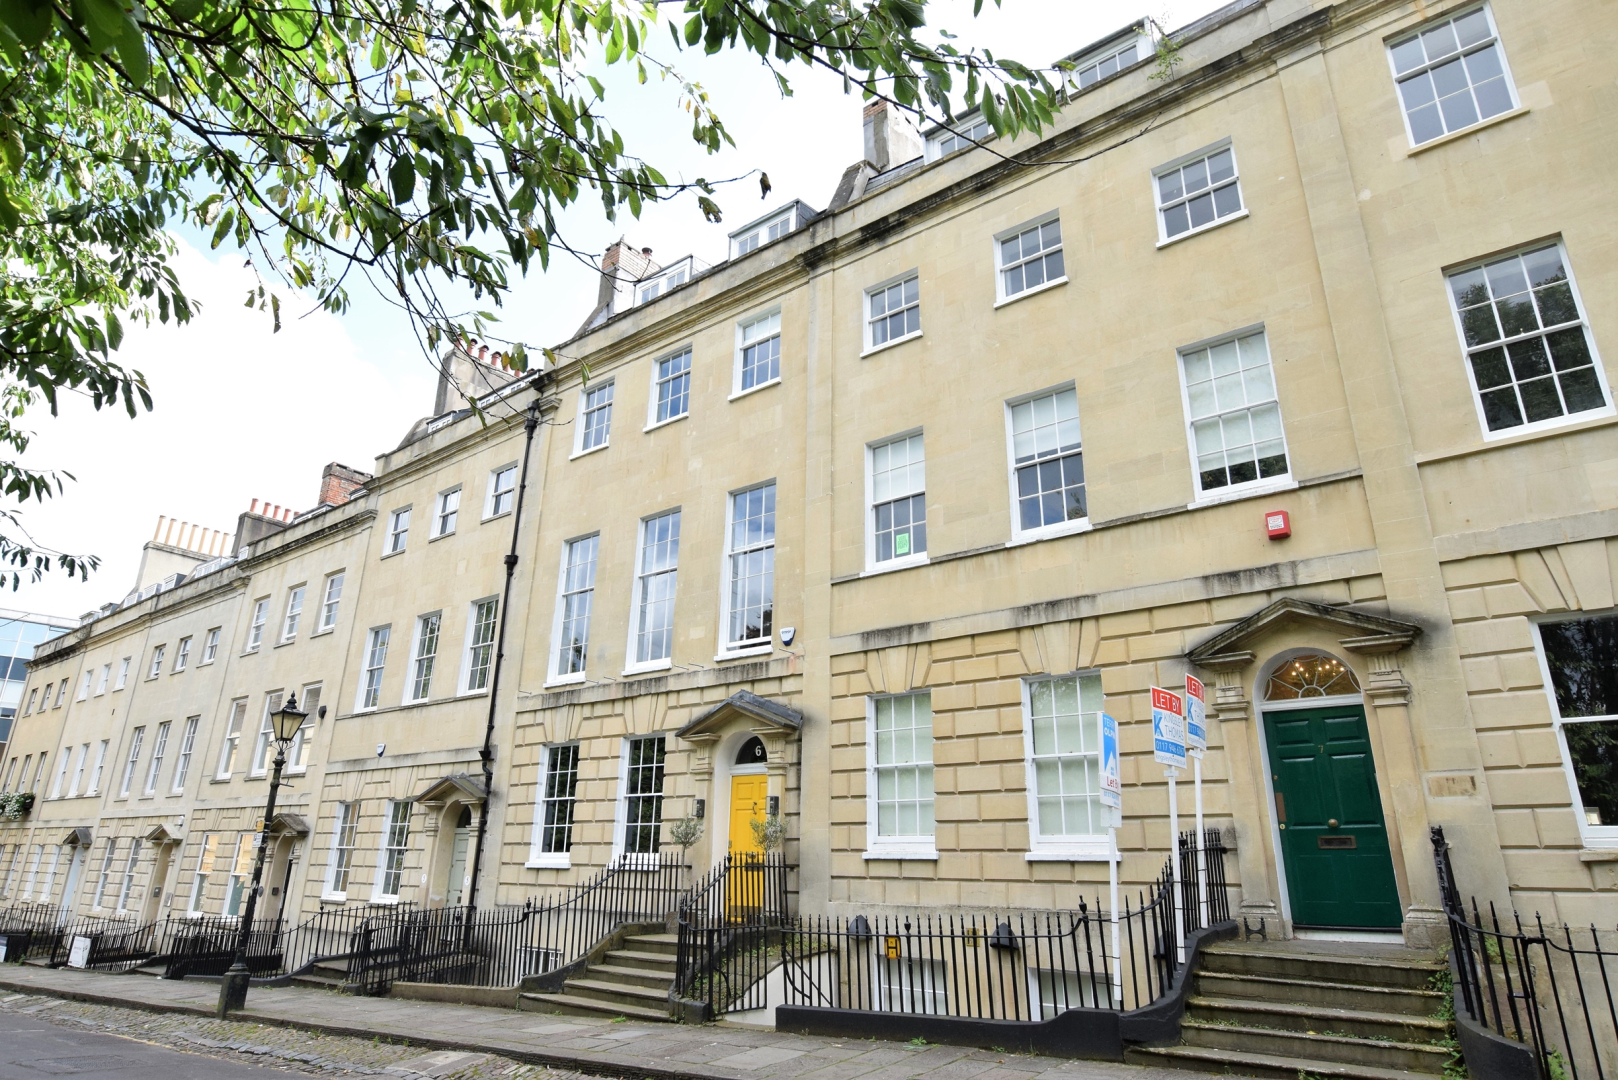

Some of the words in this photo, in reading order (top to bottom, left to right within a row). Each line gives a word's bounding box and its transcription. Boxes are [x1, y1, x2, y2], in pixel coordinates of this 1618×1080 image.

[1188, 679, 1198, 695] LET
[1155, 692, 1171, 708] LET
[1172, 697, 1180, 713] BY
[1165, 725, 1184, 741] THOMAS
[755, 745, 762, 756] 6
[1156, 741, 1168, 751] 0117
[1318, 745, 1323, 753] 7
[1106, 776, 1115, 788] Let
[887, 938, 898, 957] H
